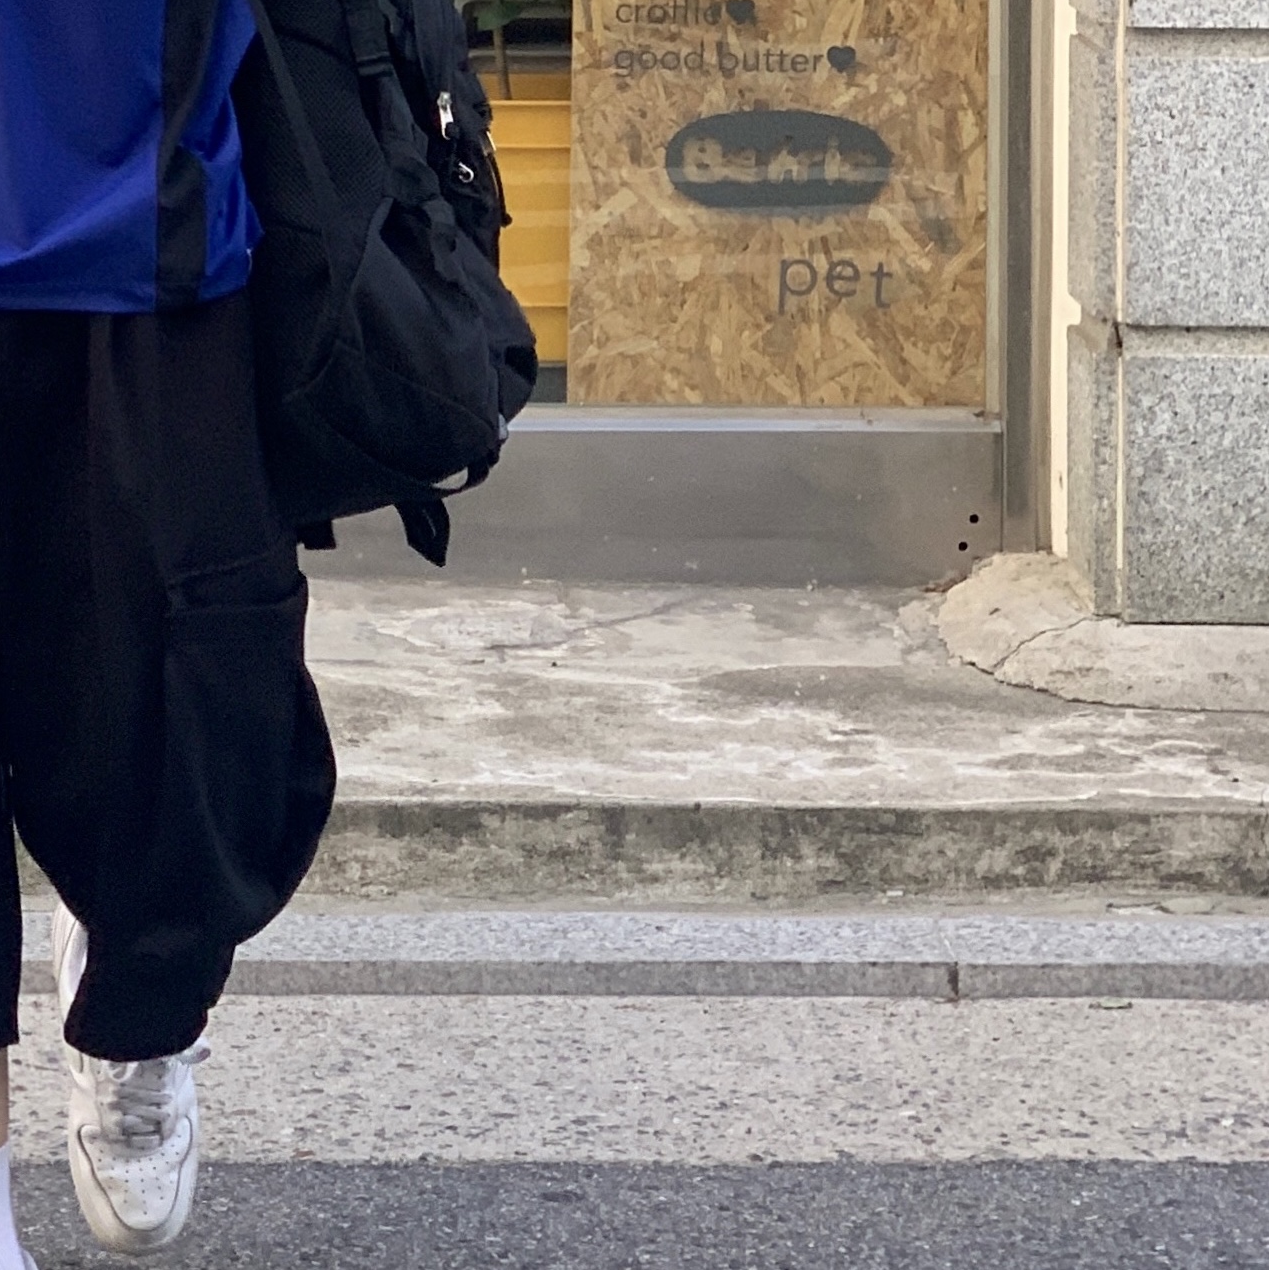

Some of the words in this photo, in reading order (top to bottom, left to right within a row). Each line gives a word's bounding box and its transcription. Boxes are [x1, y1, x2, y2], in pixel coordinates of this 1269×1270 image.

[614, 37, 706, 77] good
[716, 40, 825, 74] butter
[778, 256, 893, 314] pet
